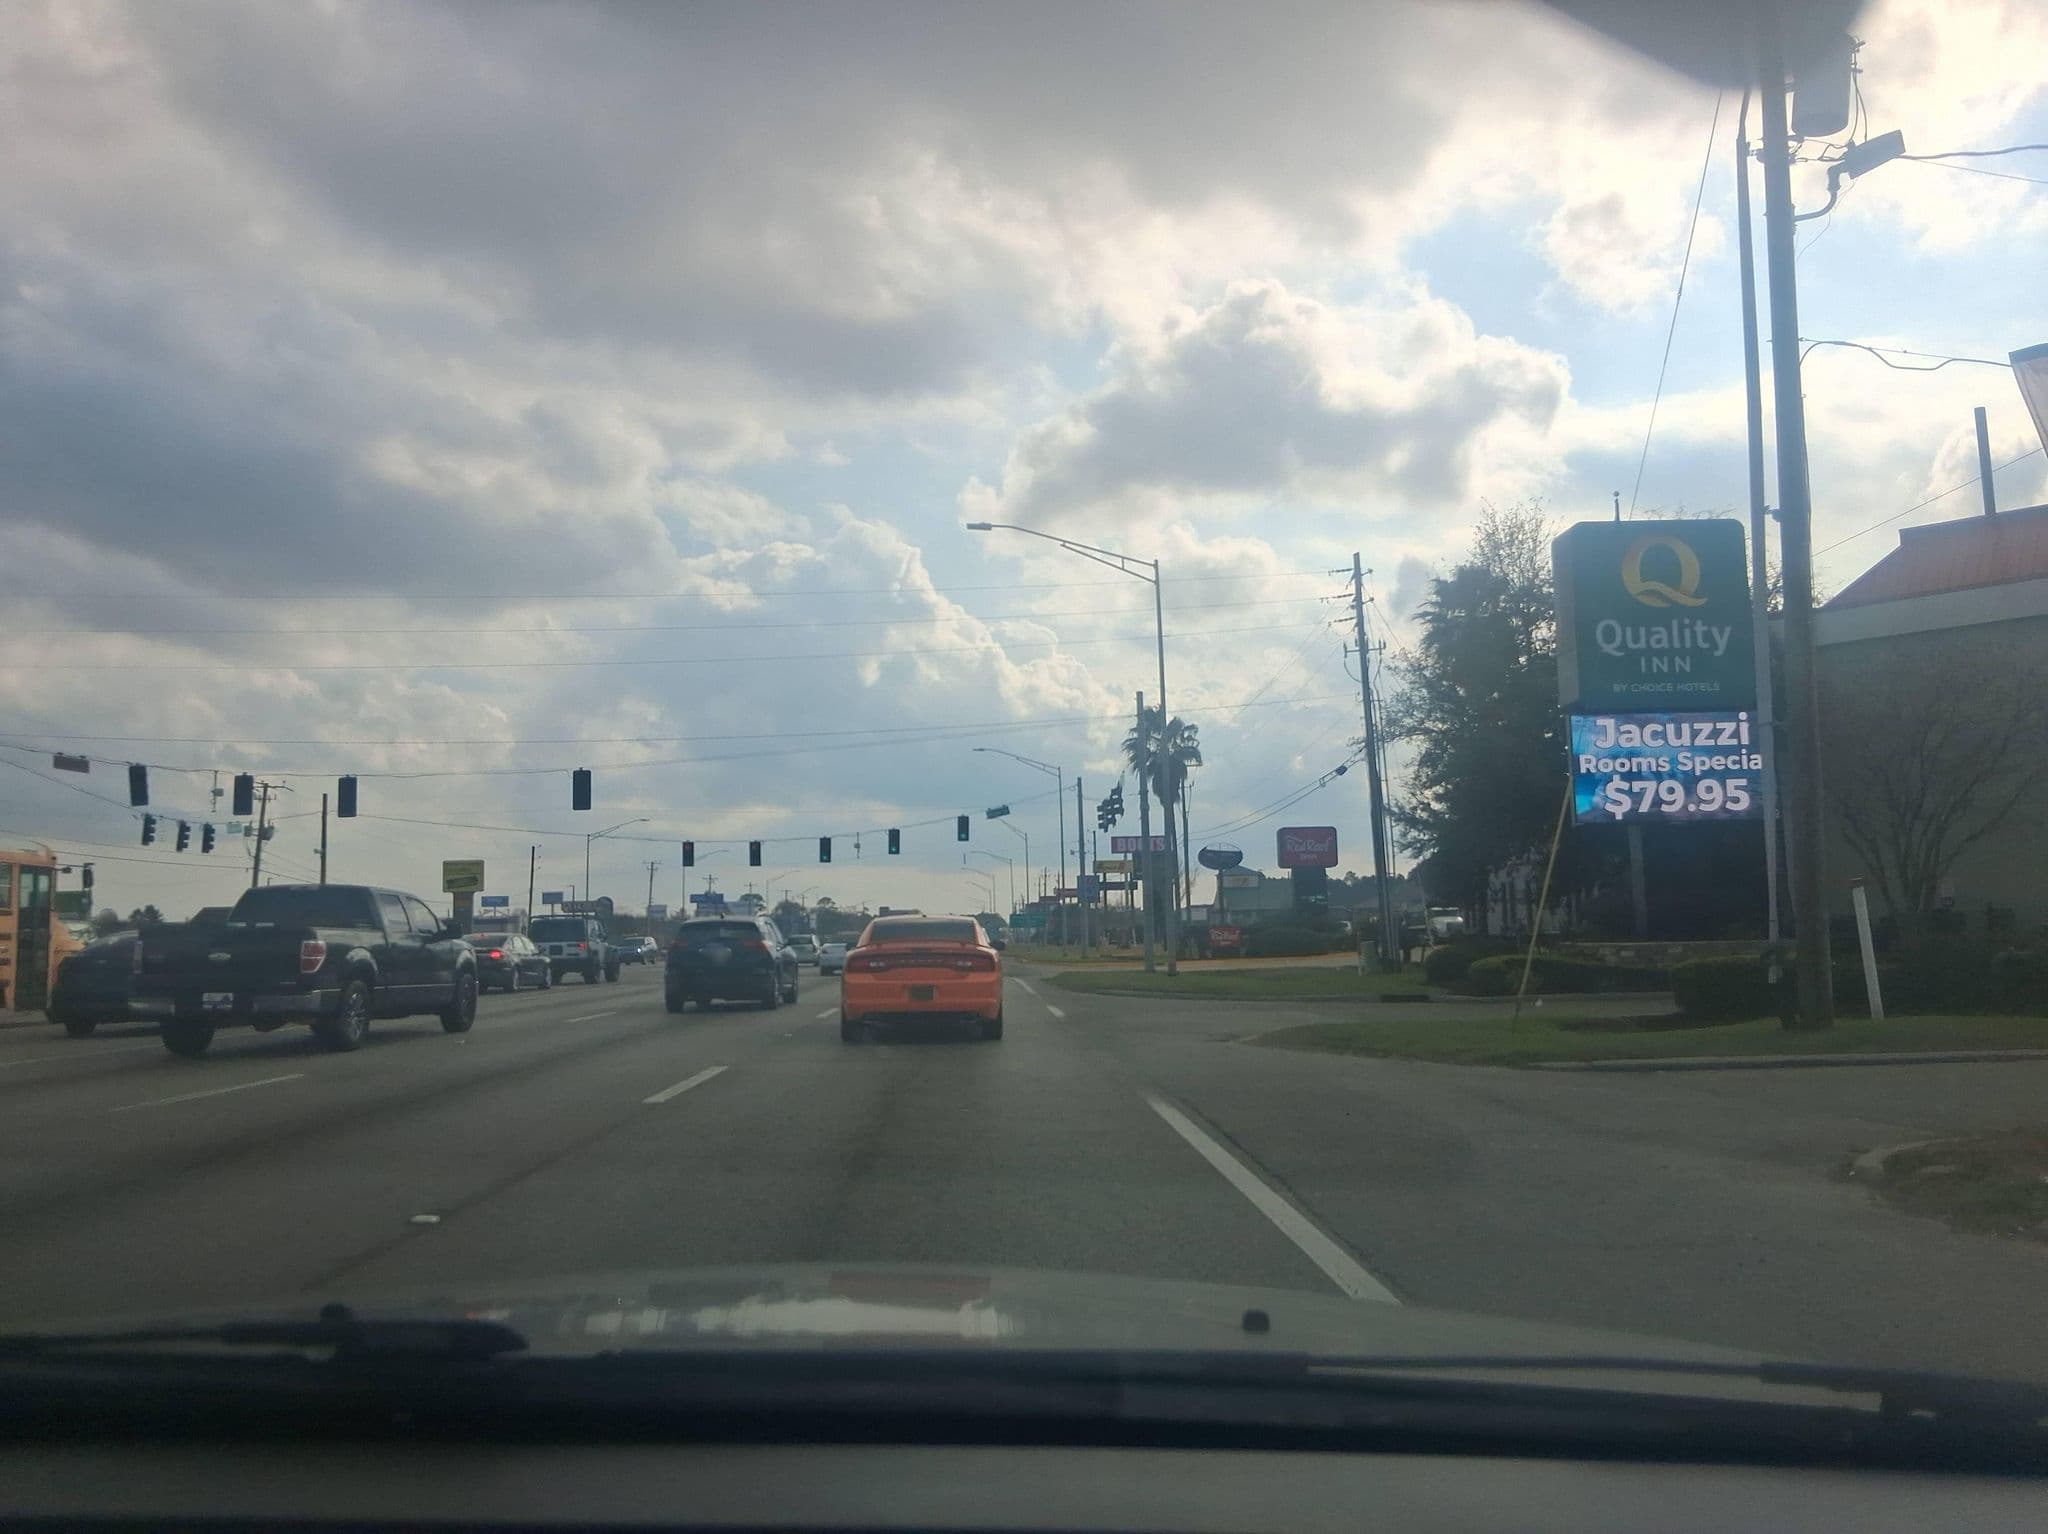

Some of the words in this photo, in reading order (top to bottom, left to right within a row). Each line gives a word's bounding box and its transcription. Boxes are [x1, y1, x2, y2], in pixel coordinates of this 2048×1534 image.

[1595, 618, 1732, 656] Quality
[1640, 655, 1692, 673] INN
[1612, 683, 1627, 693] BY
[1631, 682, 1673, 693] CHOICE
[1676, 681, 1721, 692] HOTELS
[1594, 712, 1750, 749] Jacuzzi
[1579, 754, 1671, 774] Rooms
[1677, 748, 1762, 775] Specia
[1603, 774, 1751, 820] $79.95
